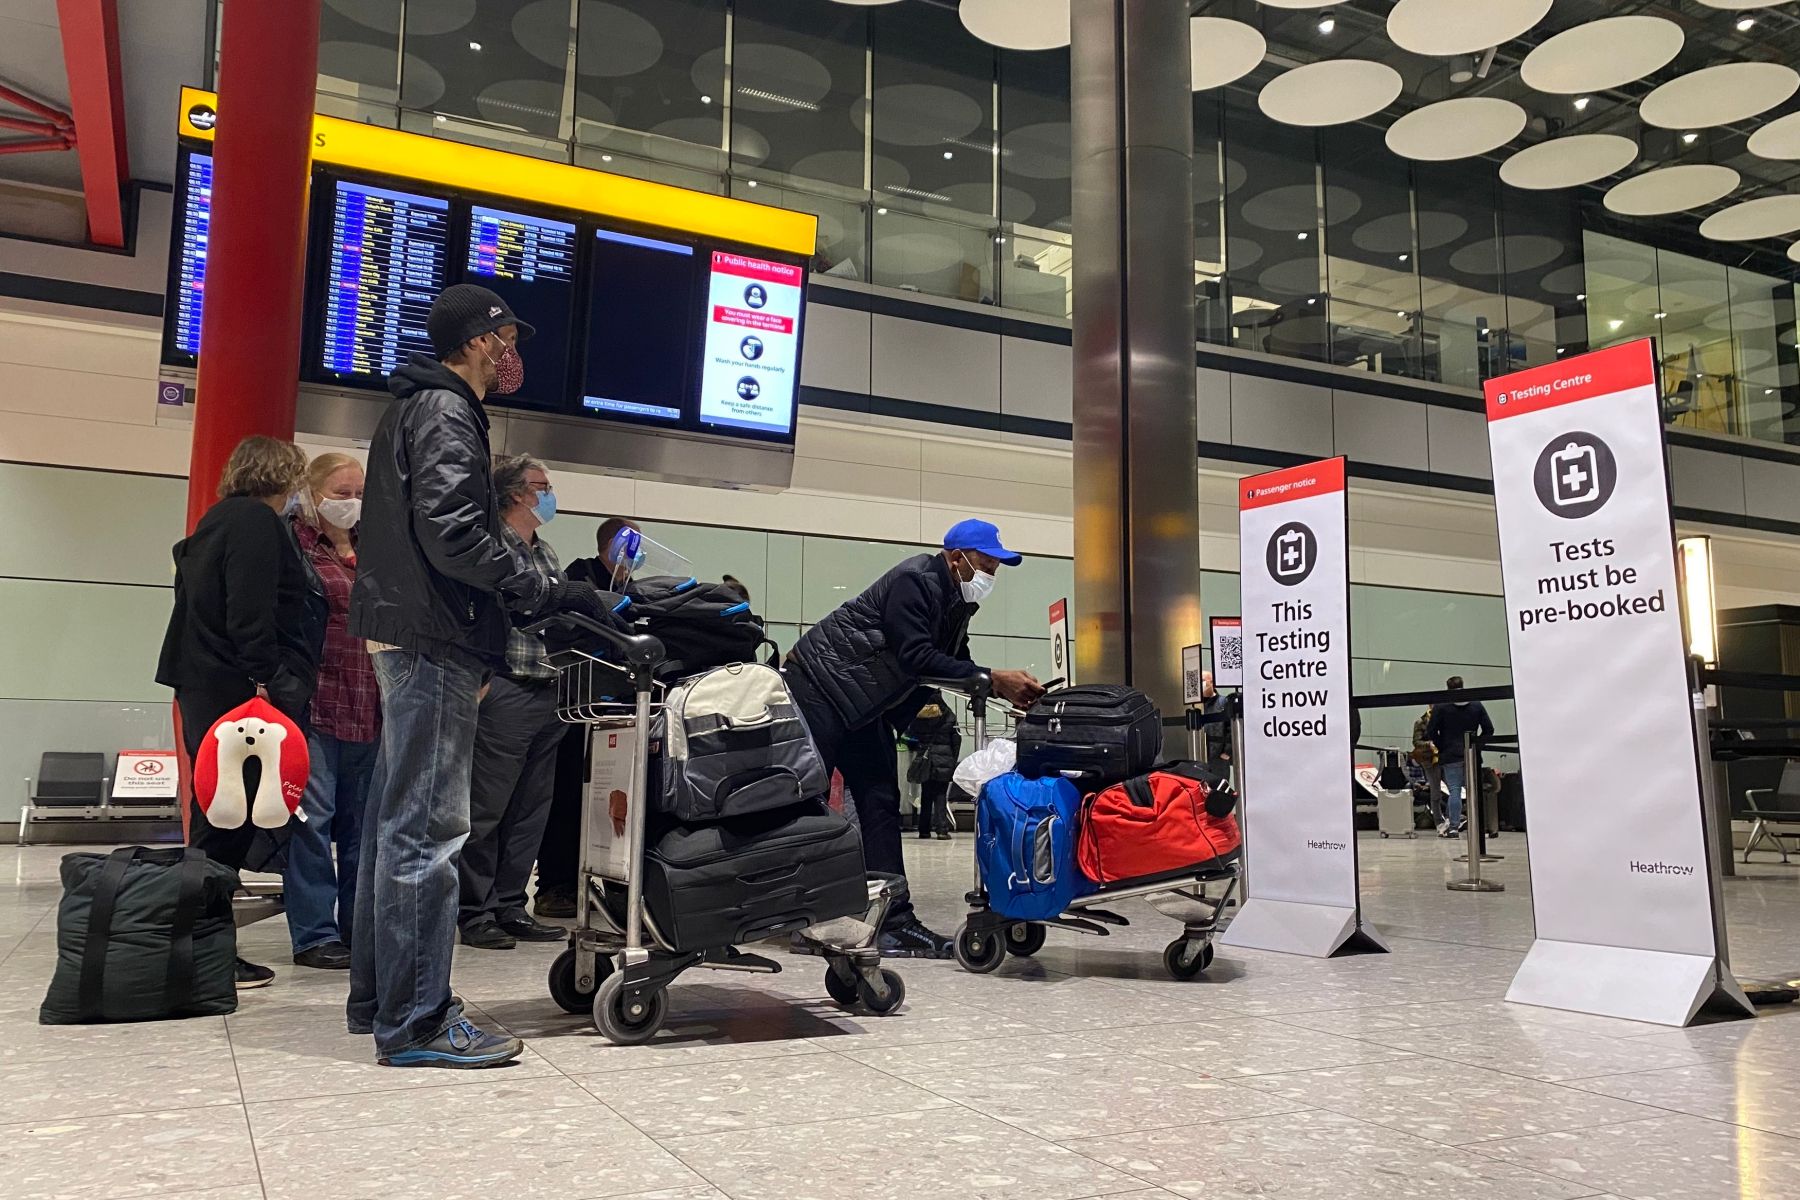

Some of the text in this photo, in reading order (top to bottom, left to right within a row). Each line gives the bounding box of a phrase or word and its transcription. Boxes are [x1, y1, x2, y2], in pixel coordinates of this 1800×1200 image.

[724, 256, 794, 276] Public health notice
[721, 315, 745, 326] covering
[762, 321, 786, 331] terminal
[725, 308, 737, 317] You
[737, 311, 749, 319] must
[770, 316, 782, 324] face
[715, 357, 785, 373] Wash your hands regularly
[1510, 372, 1592, 401] Testing Centre
[721, 400, 733, 408] Keep
[751, 404, 773, 412] distance
[745, 409, 762, 417] others
[1255, 477, 1316, 498] Passenger notice
[1550, 538, 1615, 563] Tests
[1538, 564, 1637, 594] must be
[1271, 599, 1312, 623] This
[1519, 589, 1665, 631] pre-booked
[1256, 628, 1330, 653] Testing
[1260, 658, 1327, 681] Centre
[1261, 688, 1328, 709] is now
[1263, 714, 1327, 737] closed
[283, 781, 302, 792] Polar
[1307, 839, 1346, 850] Heathrow
[1630, 861, 1694, 875] Heathrow
